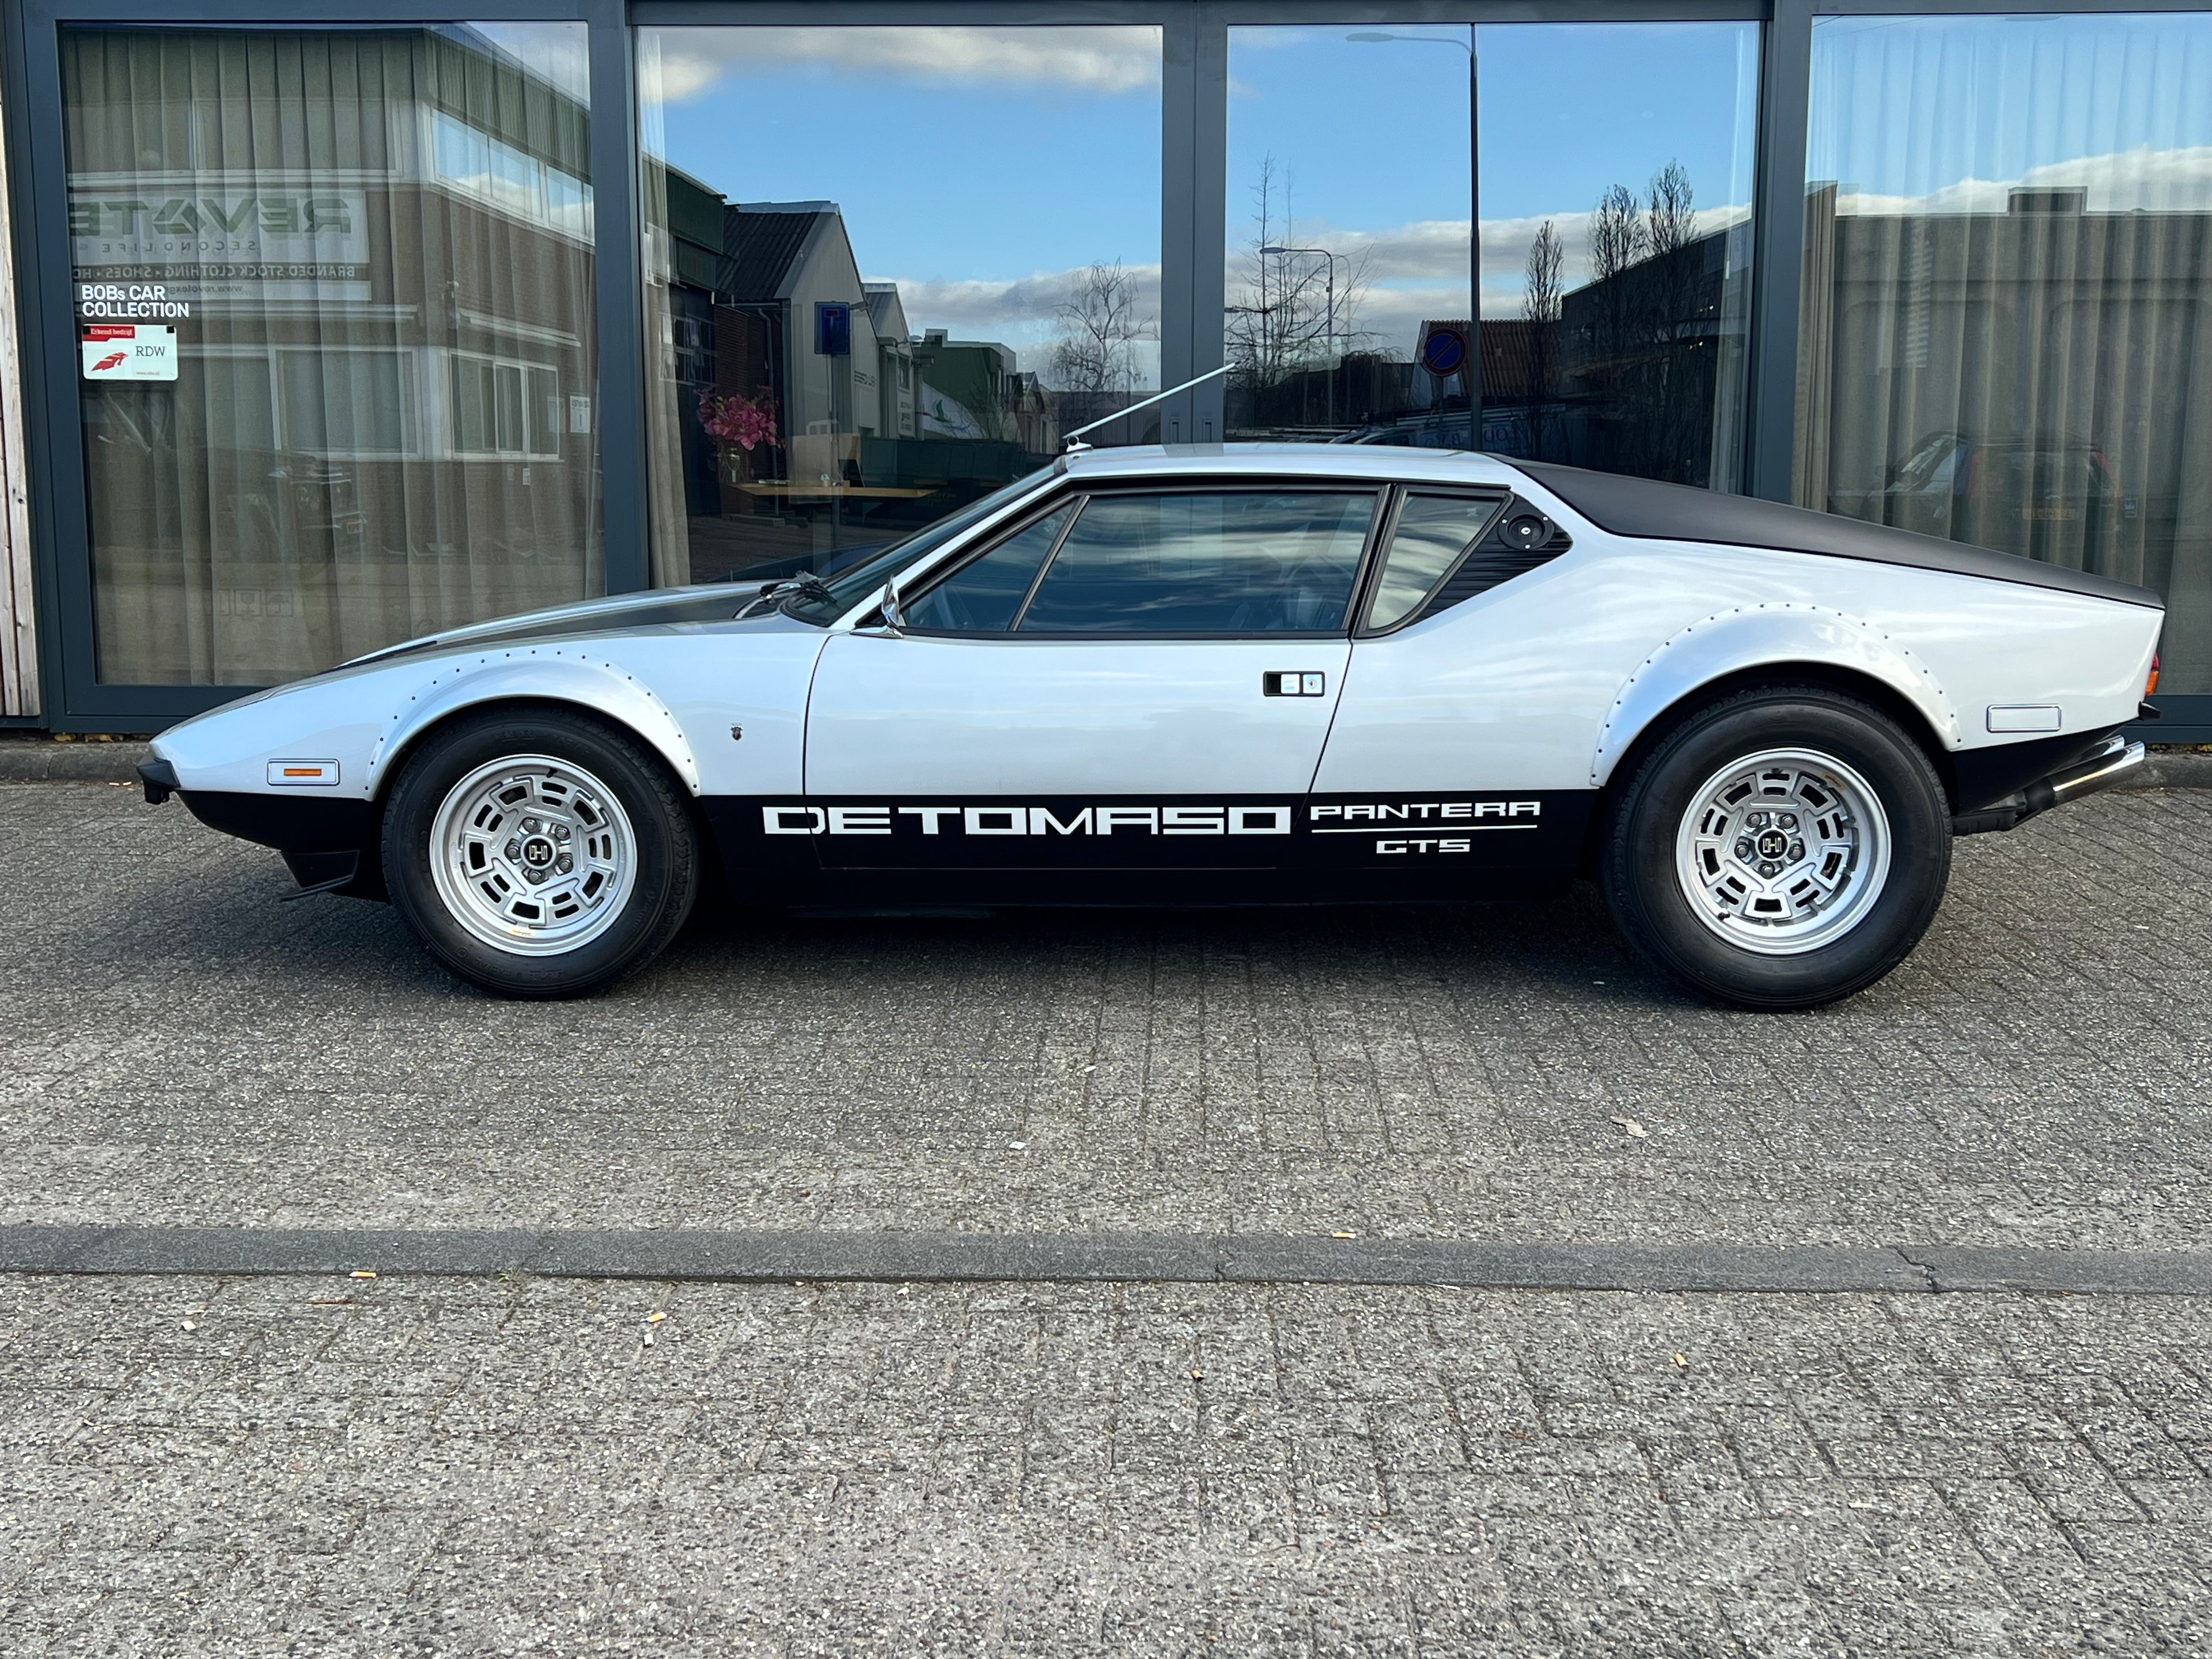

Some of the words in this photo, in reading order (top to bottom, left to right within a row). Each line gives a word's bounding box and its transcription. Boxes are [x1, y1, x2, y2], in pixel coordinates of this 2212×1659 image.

[82, 285, 126, 300] BOBs
[129, 285, 165, 300] CAR
[82, 301, 190, 317] COLLECTION
[135, 346, 165, 356] RDW
[1310, 801, 1540, 820] PANTERA
[1376, 839, 1471, 854] GTS
